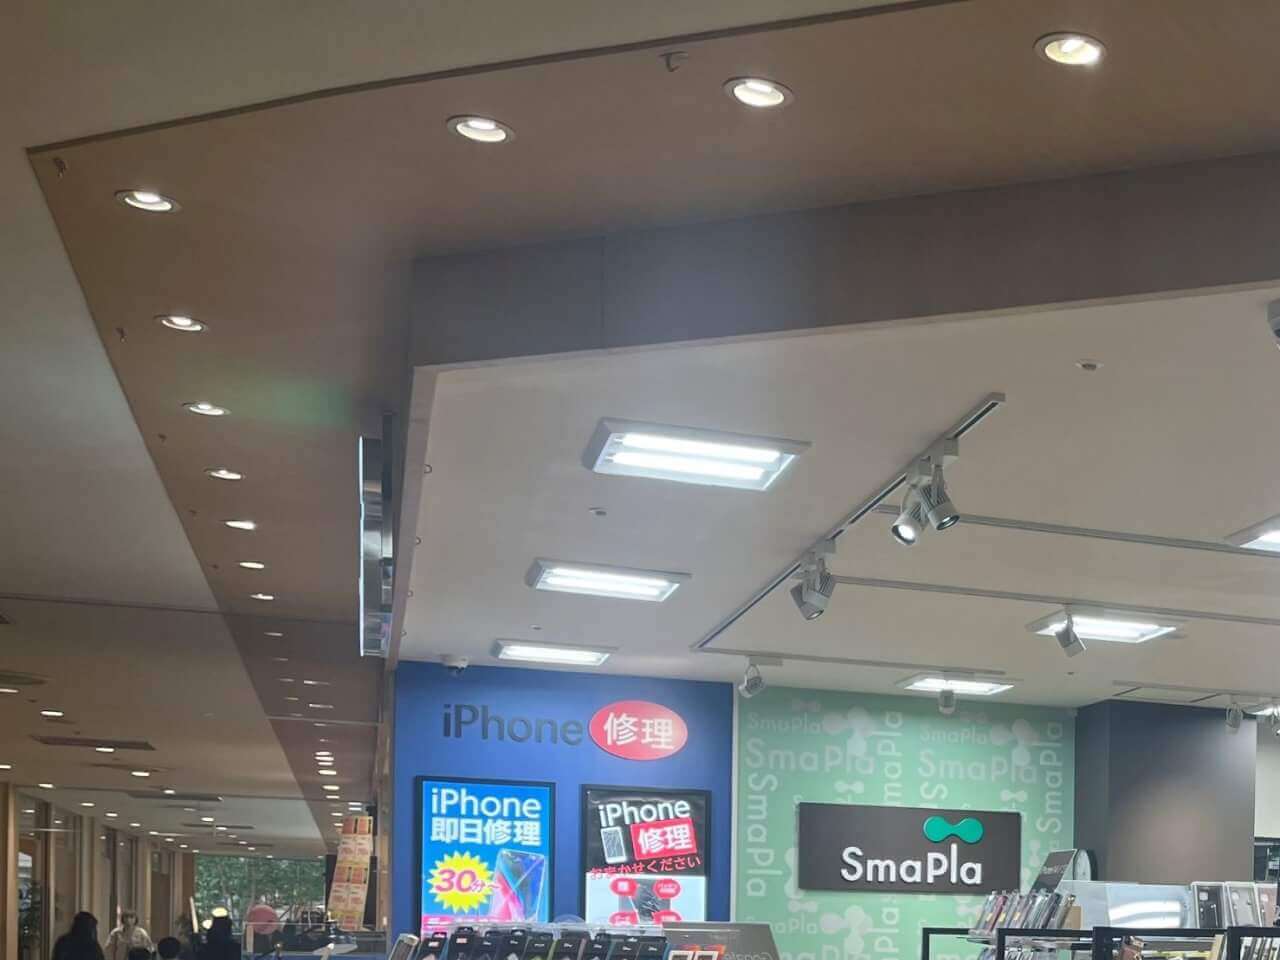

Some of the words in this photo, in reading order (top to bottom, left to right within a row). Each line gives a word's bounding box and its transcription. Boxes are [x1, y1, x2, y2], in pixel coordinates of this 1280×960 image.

[442, 704, 584, 746] iPhone
[603, 712, 675, 750] 修理
[917, 749, 1037, 784] SmaPla
[431, 787, 542, 819] iPhone
[598, 800, 692, 828] iPhone
[430, 818, 542, 846] 即日修理
[636, 824, 694, 853] 修理
[746, 772, 783, 897] SmaPla
[840, 843, 983, 885] SmaPla
